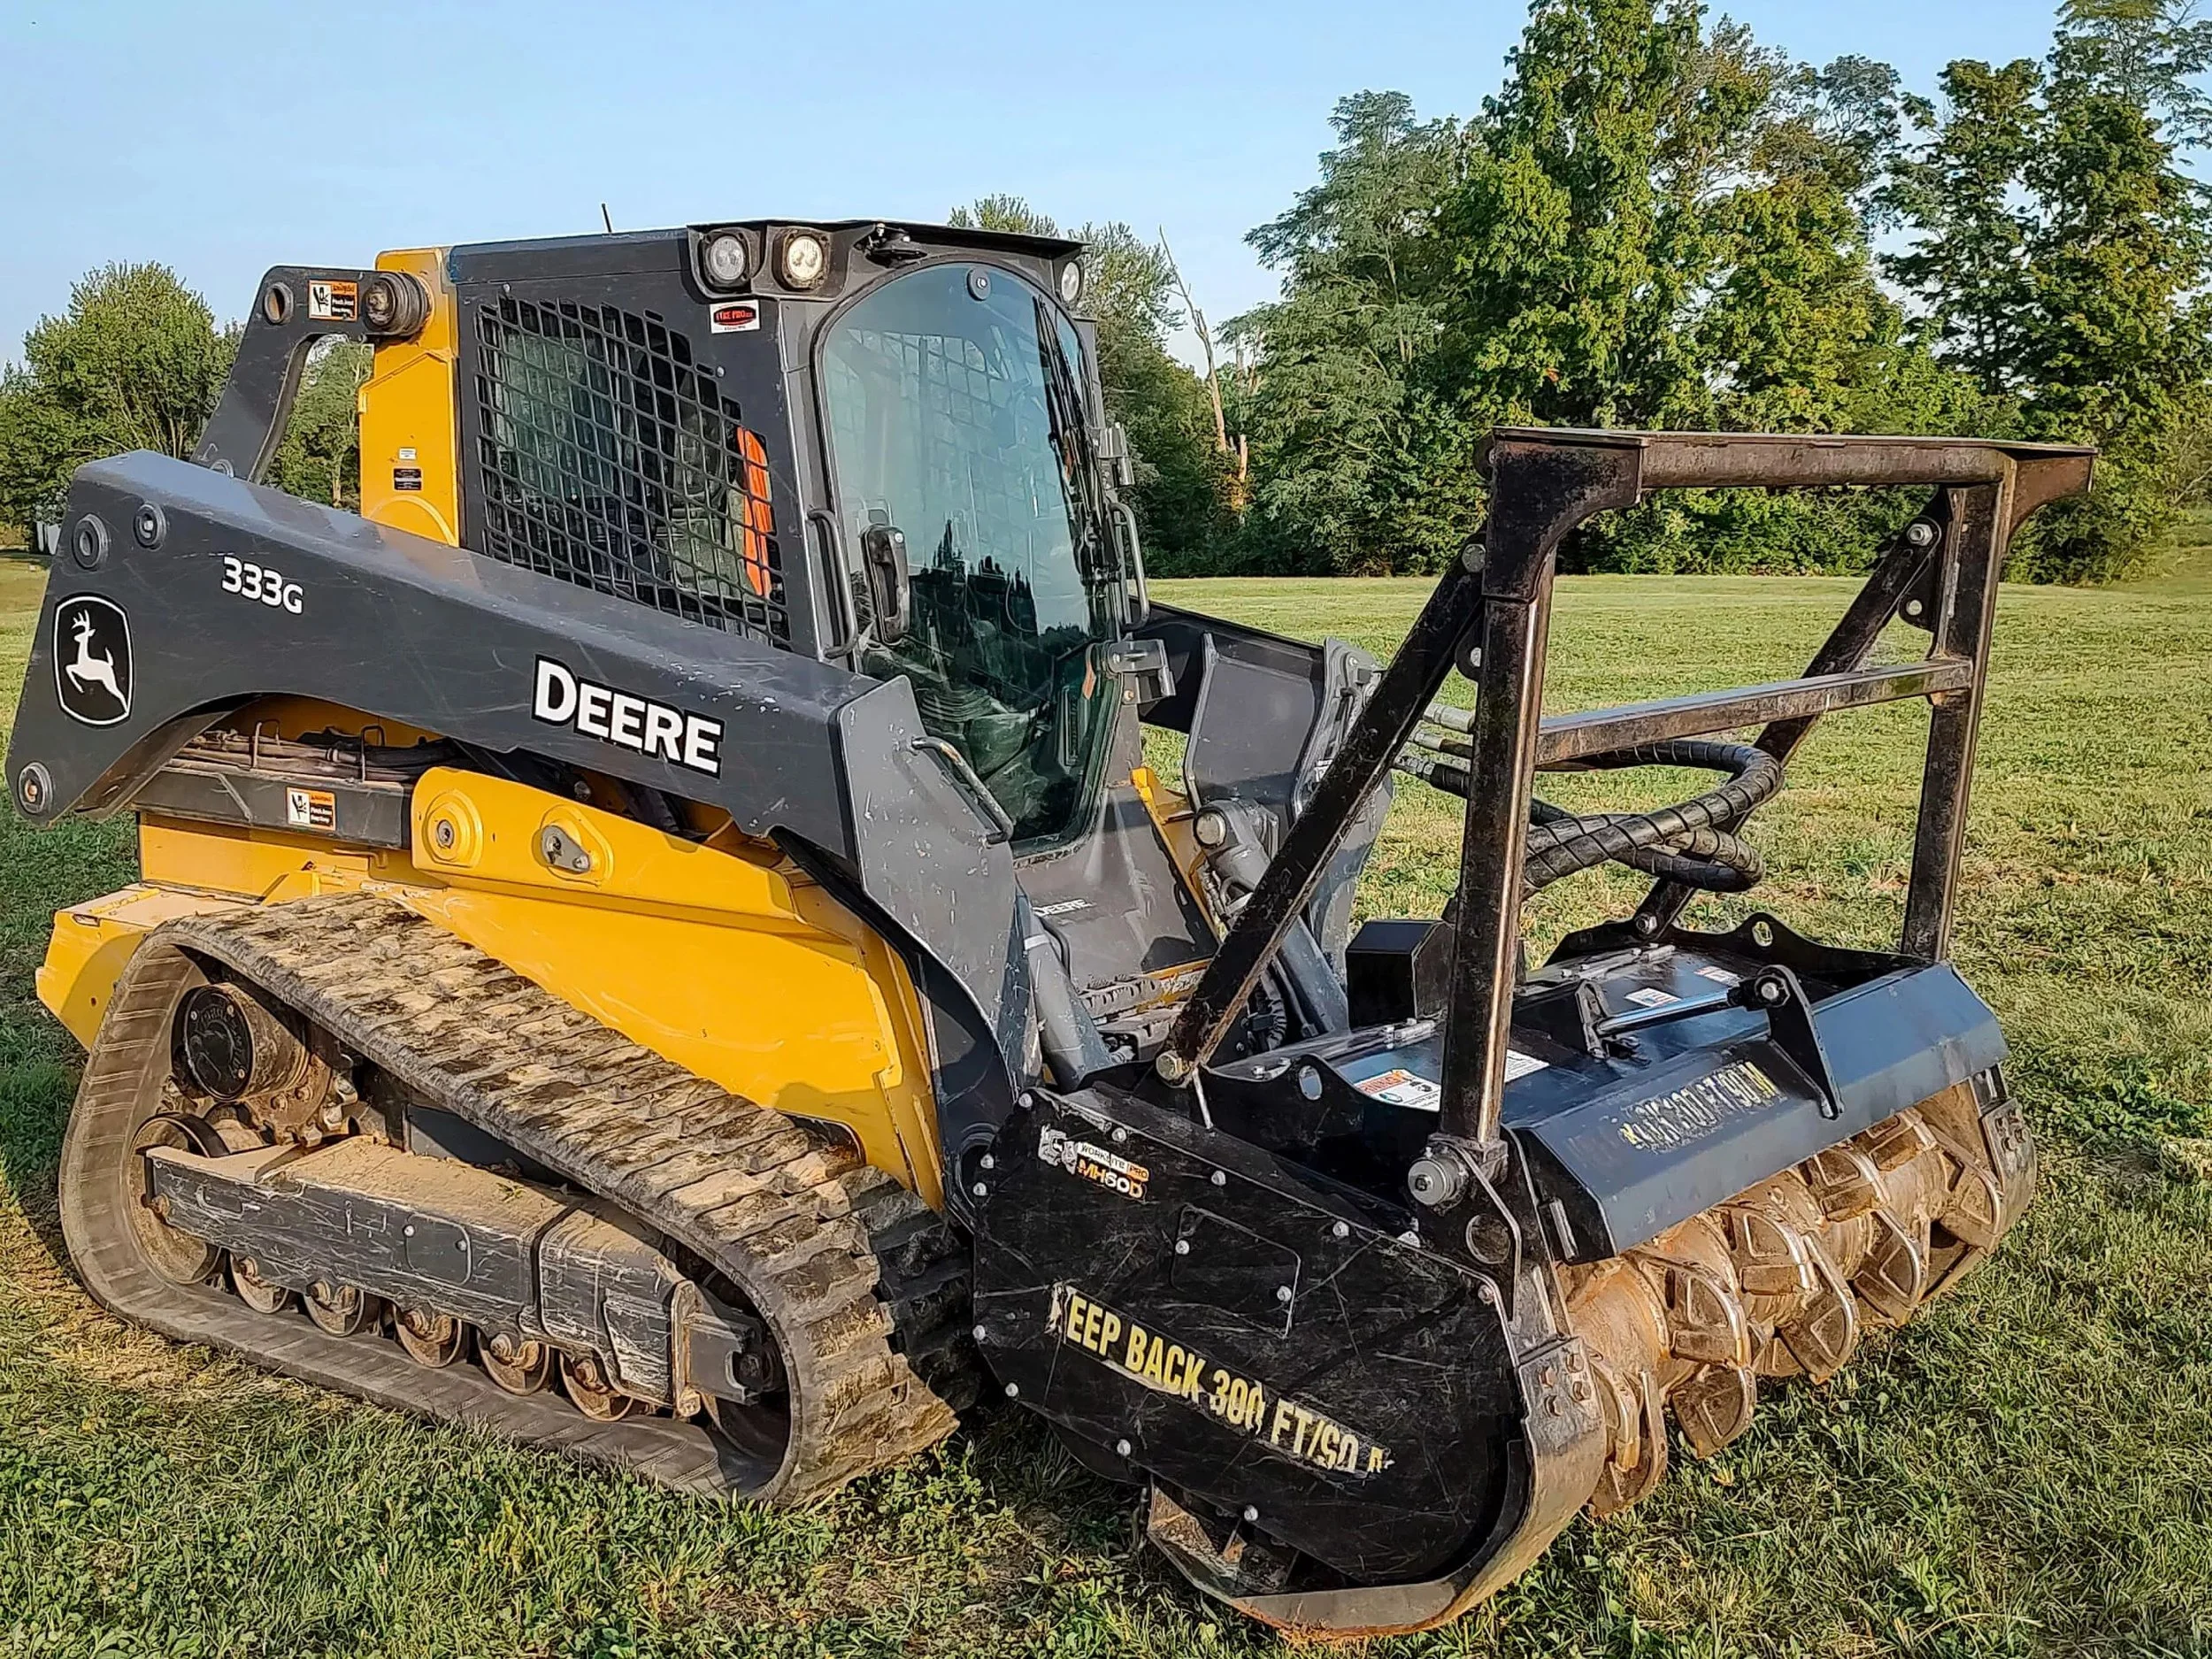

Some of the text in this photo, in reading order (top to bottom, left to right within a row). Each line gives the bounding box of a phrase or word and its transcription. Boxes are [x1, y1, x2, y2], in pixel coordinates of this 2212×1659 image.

[221, 556, 303, 614] 333G
[534, 659, 721, 773] DEERE
[1129, 1165, 1148, 1179] PRO
[1066, 1294, 1121, 1356] EEP
[1125, 1324, 1207, 1404] BACK
